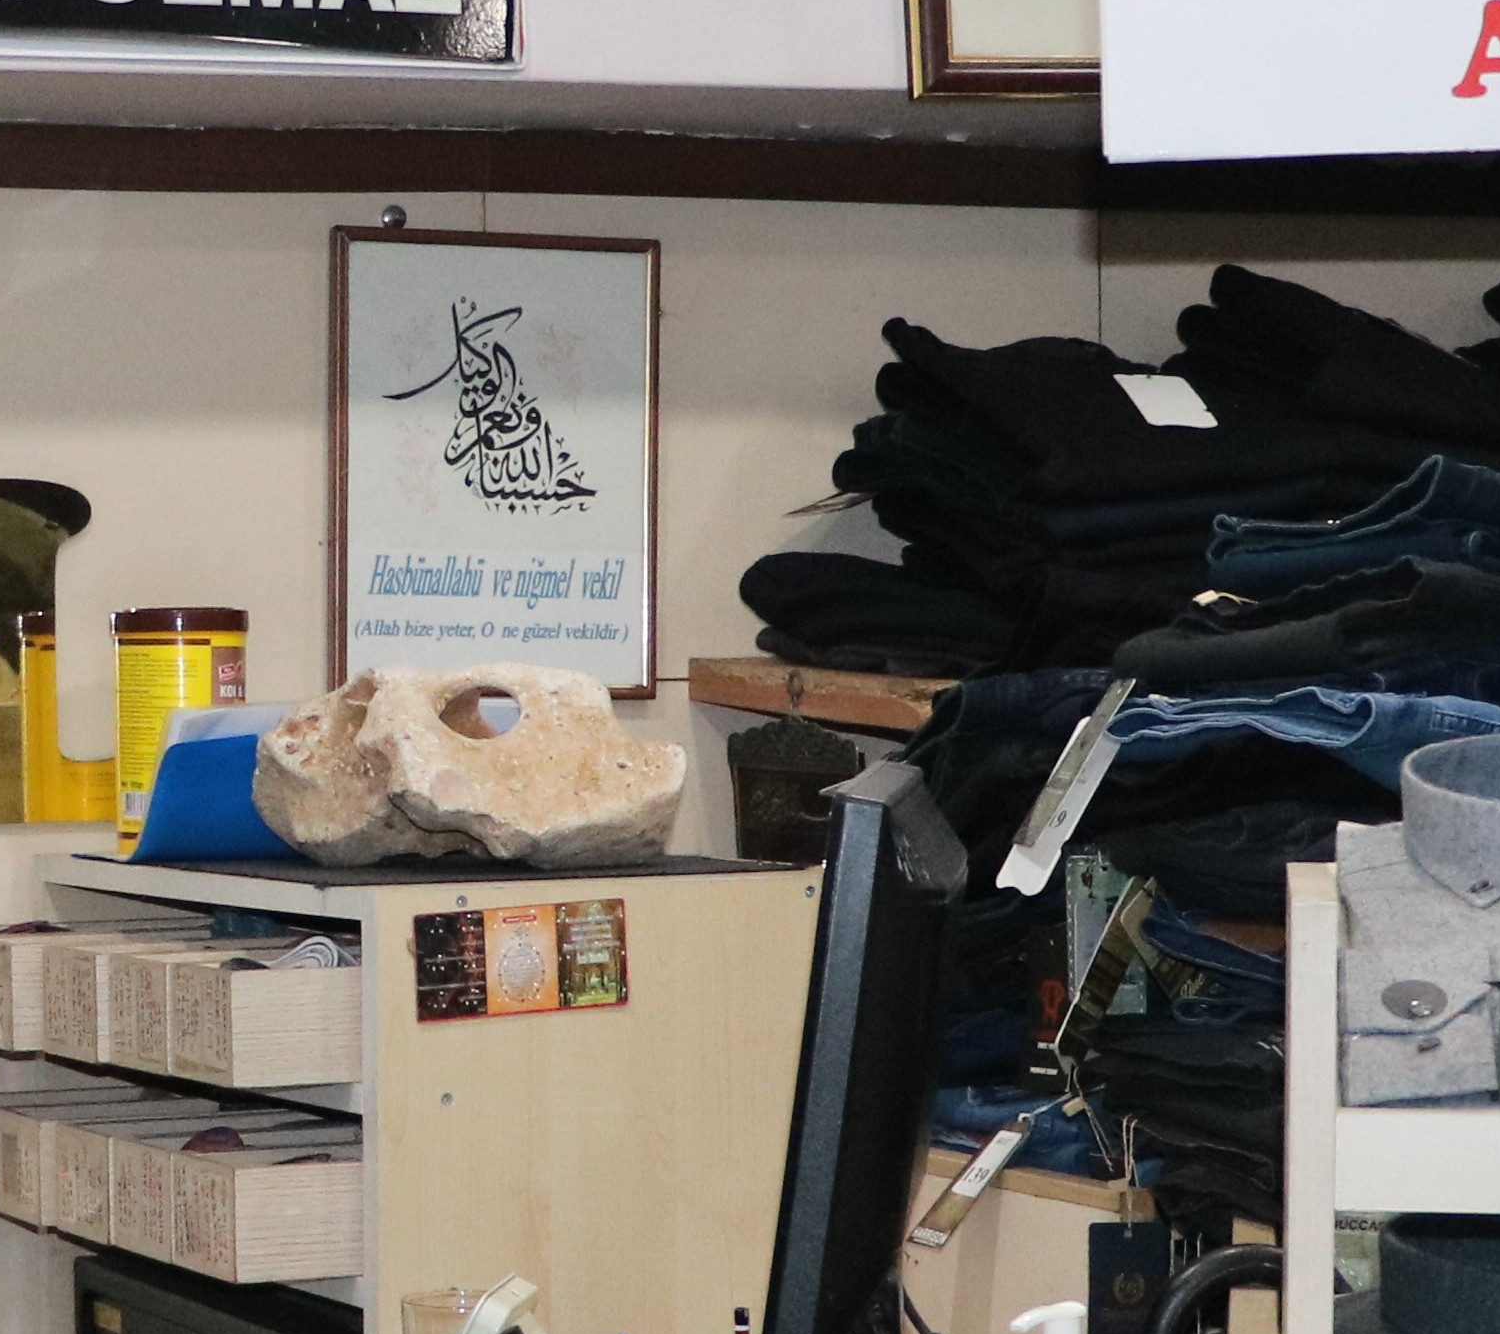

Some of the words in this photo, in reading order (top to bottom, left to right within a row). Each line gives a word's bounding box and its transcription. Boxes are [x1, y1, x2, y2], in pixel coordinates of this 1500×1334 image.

[368, 554, 485, 598] Hasbünallahü
[493, 568, 513, 598] ve
[582, 558, 625, 600] vekil
[404, 621, 434, 638] bize
[481, 622, 495, 640] O
[502, 626, 520, 640] ne
[522, 621, 562, 643] güzel
[963, 1166, 991, 1184] 139
